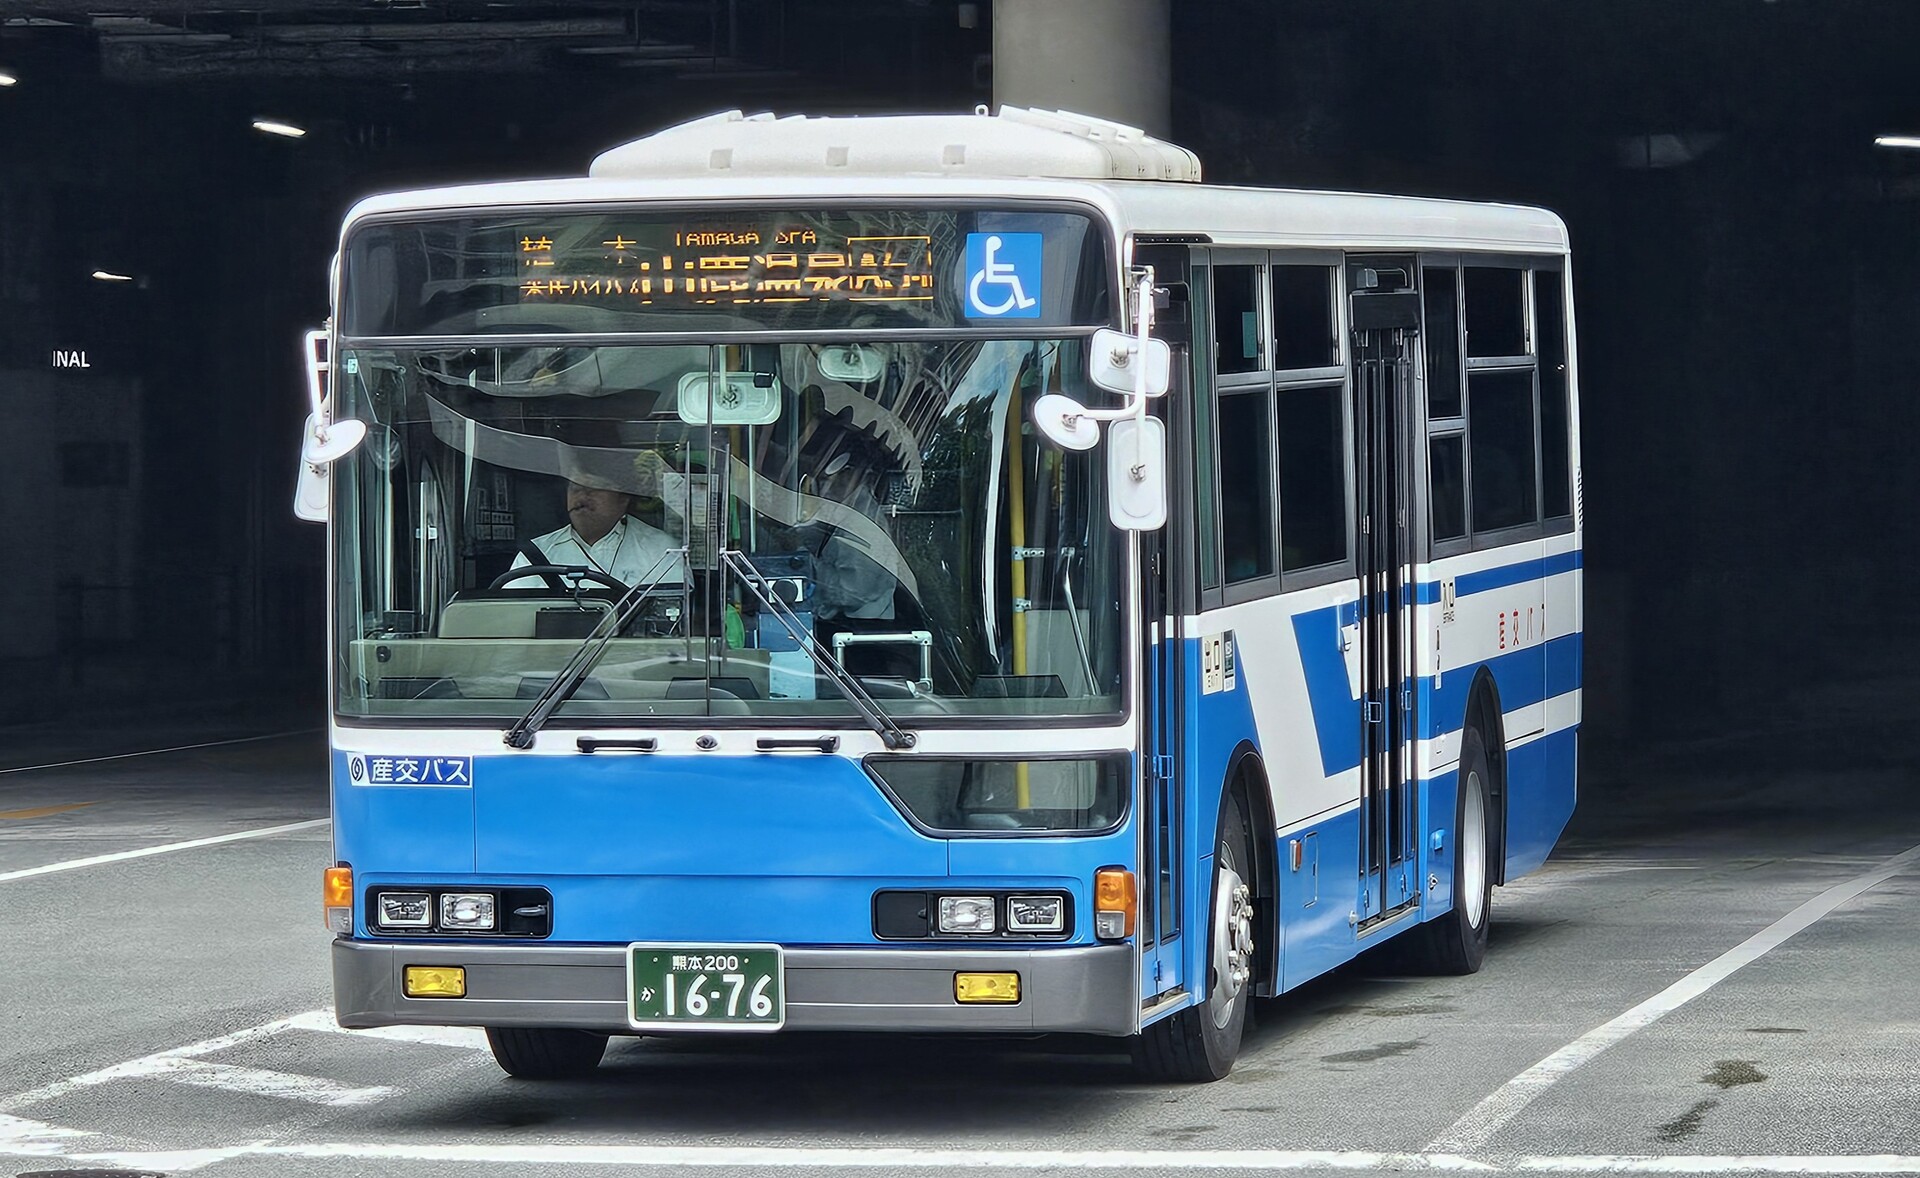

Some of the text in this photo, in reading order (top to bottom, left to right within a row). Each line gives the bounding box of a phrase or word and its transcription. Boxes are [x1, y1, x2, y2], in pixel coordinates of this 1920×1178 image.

[371, 757, 469, 783] 産交バス
[641, 973, 773, 1018] か 16-76
